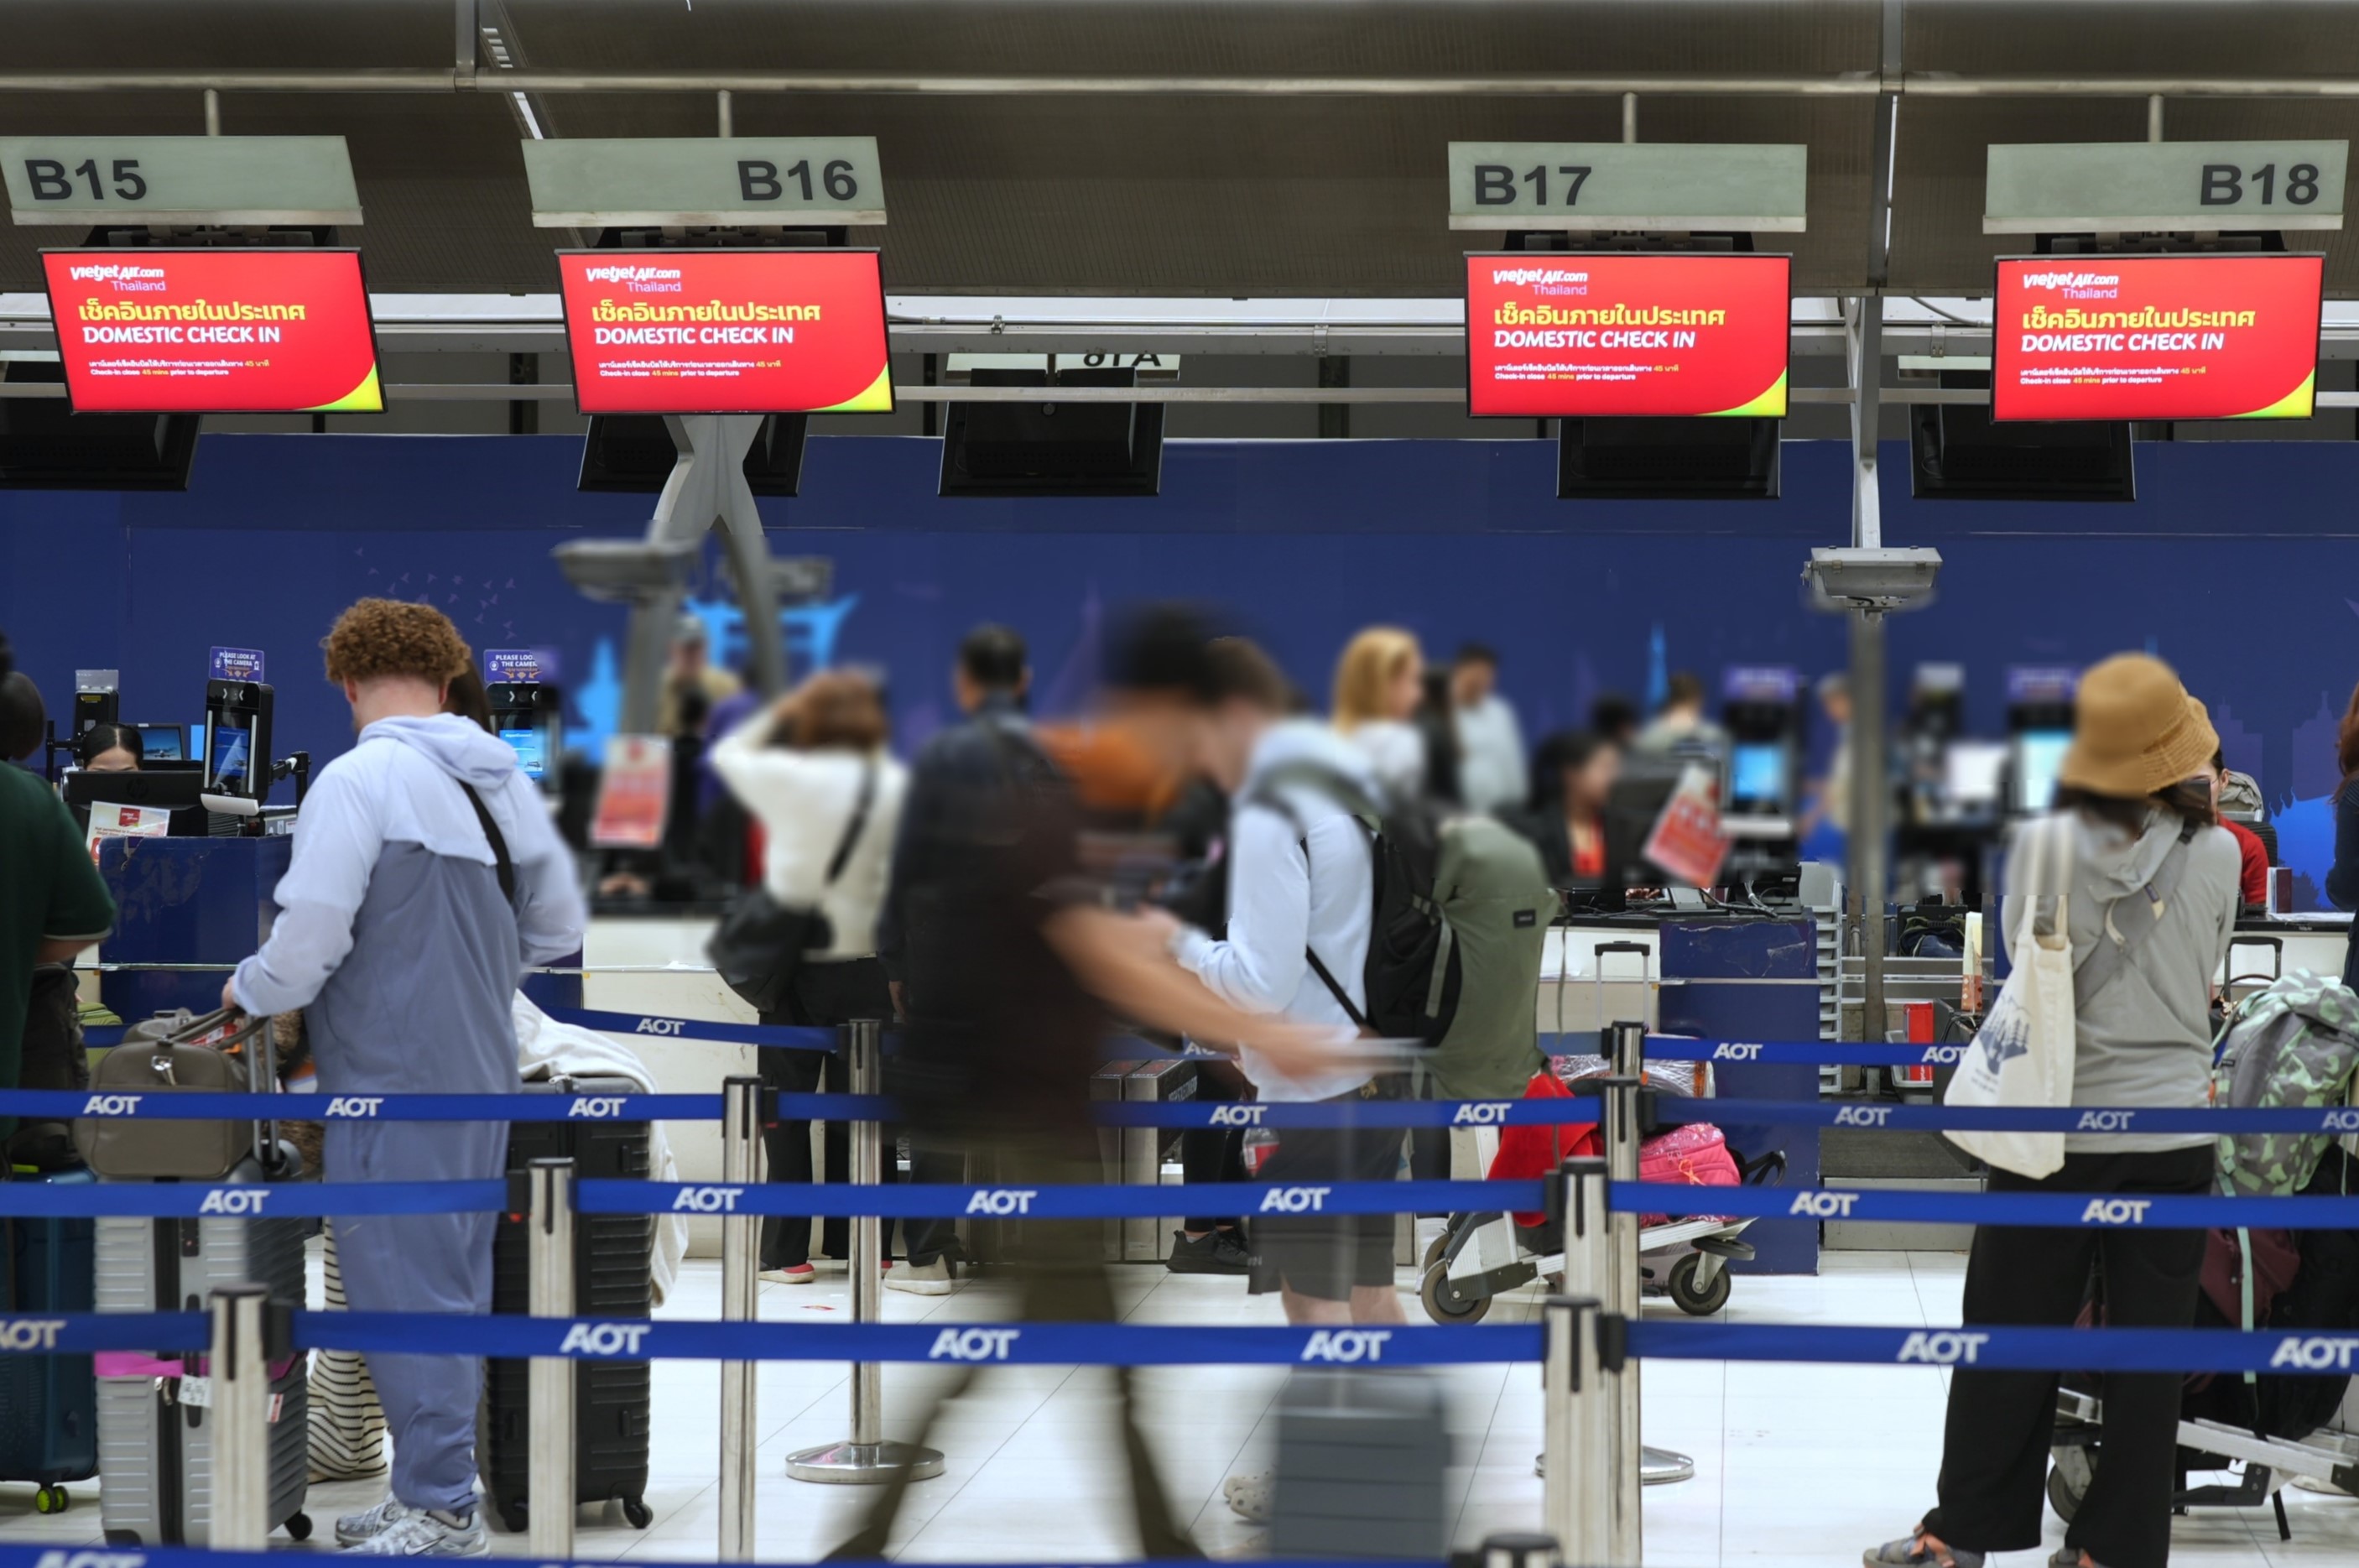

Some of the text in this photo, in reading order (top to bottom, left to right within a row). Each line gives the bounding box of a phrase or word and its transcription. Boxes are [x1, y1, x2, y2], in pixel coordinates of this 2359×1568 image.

[24, 159, 147, 201] B15
[737, 159, 857, 201] B16
[1474, 164, 1591, 206] B17
[2200, 164, 2320, 206] B18
[111, 279, 166, 291] Thailand
[627, 281, 681, 292] Thailand
[1532, 284, 1586, 295] Thailand
[2062, 287, 2117, 299] Thailand
[79, 298, 305, 320] เช็คอินภายในประเทศ
[592, 300, 820, 321] เช็คอินภายในประเทศ
[1495, 301, 1725, 325] เช็คอินภายในประเทศ
[2023, 305, 2255, 329] เช็คอินภายในประเทศ
[83, 326, 279, 343] DOMESTIC CHECK IN
[595, 327, 793, 344] DOMESTIC CHECK IN
[1495, 331, 1695, 347] DOMESTIC CHECK IN
[2022, 333, 2224, 352] DOMESTIC CHECK IN
[636, 1018, 685, 1036] AOT
[1713, 1043, 1763, 1060] AOT
[84, 1096, 142, 1115] AOT
[325, 1097, 383, 1117] AOT
[569, 1097, 626, 1117] AOT
[1210, 1106, 1268, 1125] AOT
[1454, 1103, 1512, 1123] AOT
[1835, 1106, 1892, 1126] AOT
[2078, 1110, 2134, 1130] AOT
[2322, 1112, 2359, 1129] AO
[200, 1190, 269, 1213] AOT
[673, 1187, 743, 1211] AOT
[966, 1190, 1036, 1214] AOT
[1260, 1187, 1331, 1211] AOT
[1789, 1191, 1858, 1216] AOT
[2082, 1200, 2150, 1223] AOT
[0, 1320, 67, 1350] OT
[560, 1324, 650, 1355] AOT
[929, 1329, 1018, 1359] AOT
[1302, 1331, 1391, 1362] AOT
[1898, 1332, 1988, 1363] AOT
[2270, 1337, 2359, 1368] AOT
